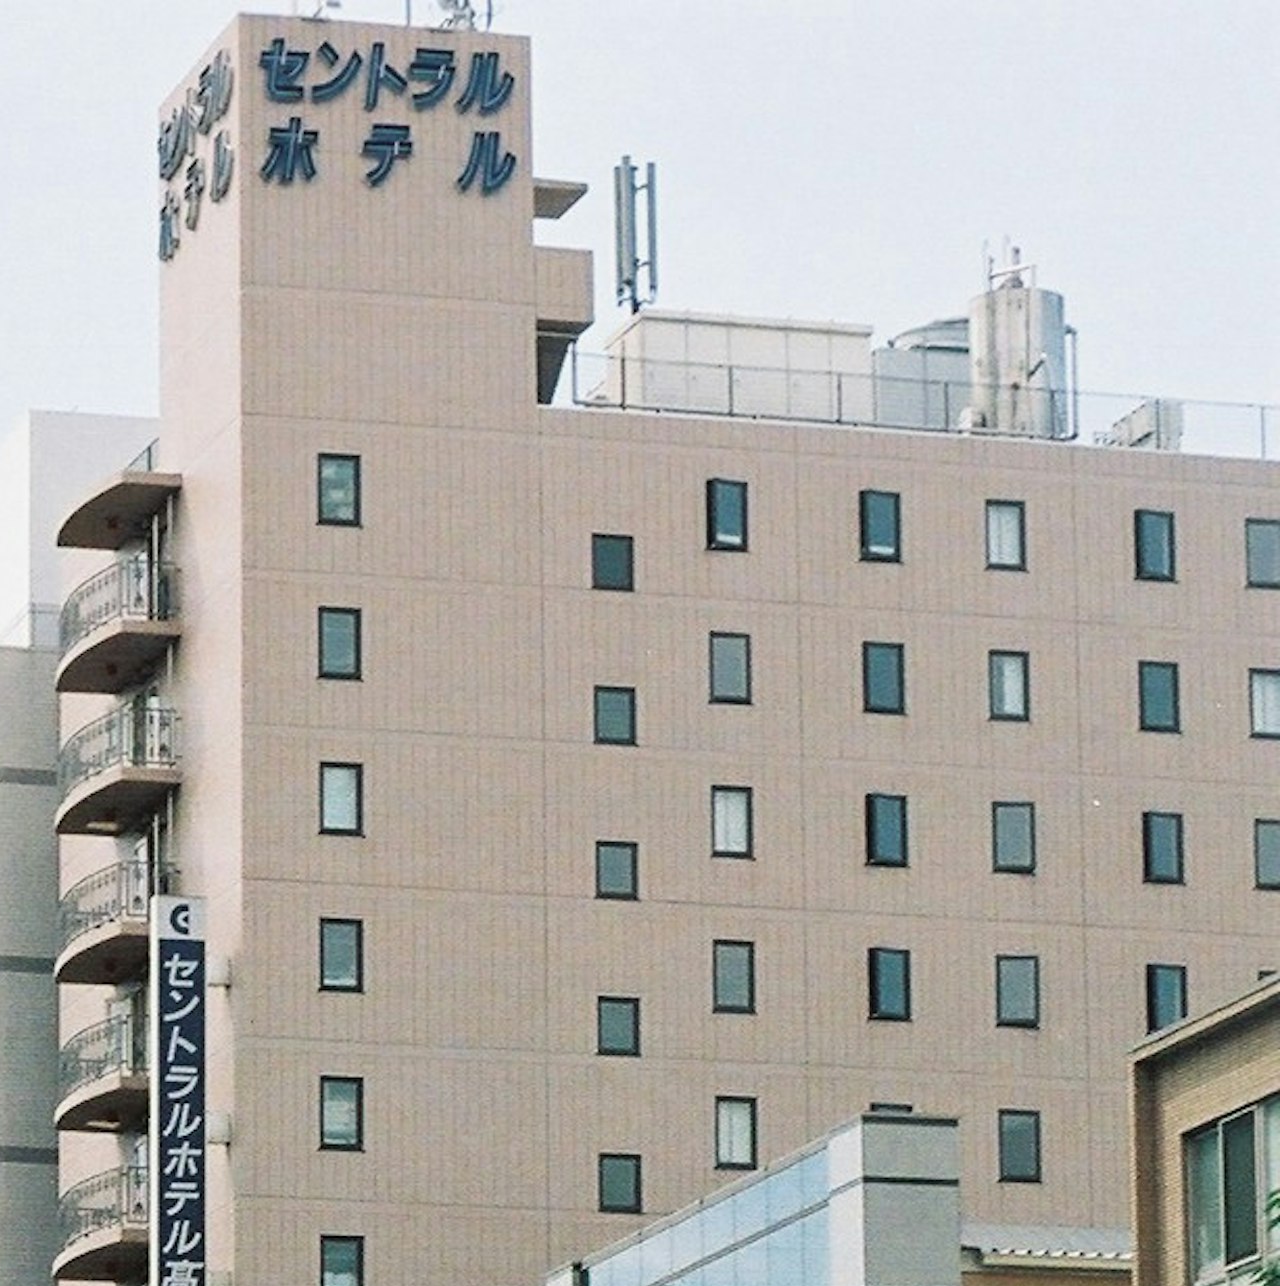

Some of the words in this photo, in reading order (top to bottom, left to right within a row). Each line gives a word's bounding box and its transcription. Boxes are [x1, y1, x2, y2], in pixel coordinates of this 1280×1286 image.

[260, 37, 516, 117] セントラル
[260, 116, 517, 196] ホテル
